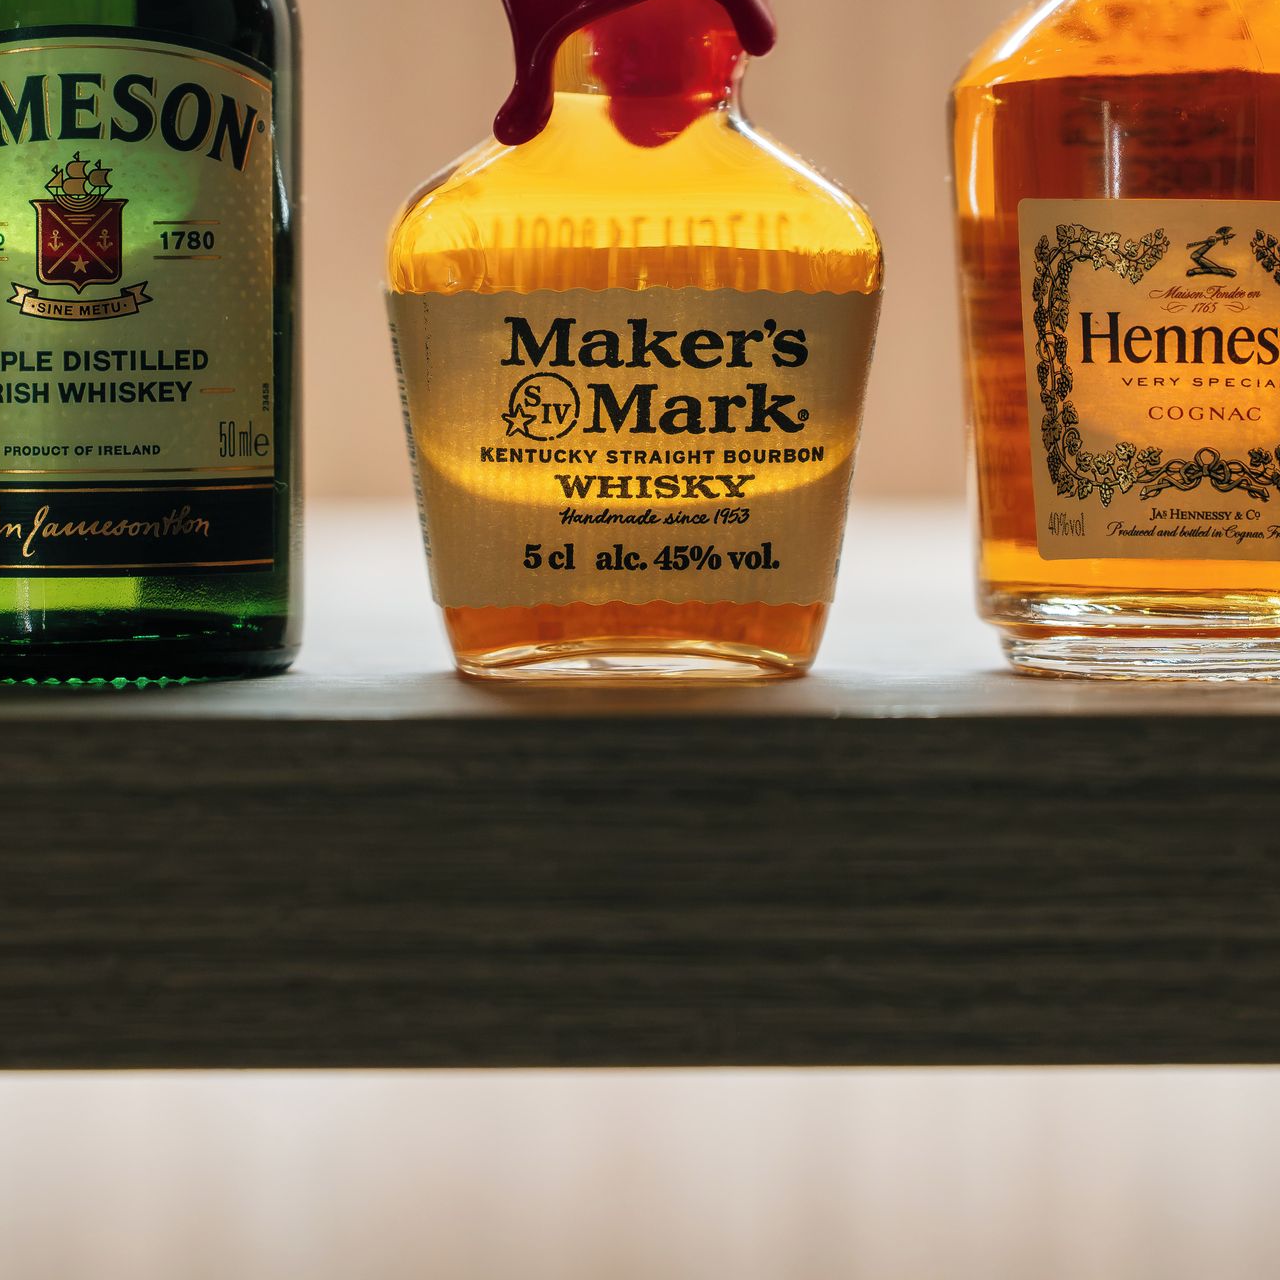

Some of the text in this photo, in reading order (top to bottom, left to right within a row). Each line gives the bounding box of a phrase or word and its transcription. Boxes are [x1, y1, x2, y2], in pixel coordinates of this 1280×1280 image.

[160, 231, 215, 251] 1780
[1149, 285, 1203, 299] Maison
[1247, 291, 1261, 299] en
[37, 300, 121, 316] SINE METU
[1191, 302, 1218, 314] 1765
[500, 317, 809, 368] Maker's
[63, 349, 208, 371] DISTILLED
[1122, 377, 1180, 387] VERY
[59, 381, 193, 403] WHISKEY
[583, 382, 804, 434] Mark
[1149, 406, 1261, 422] COGNAC
[4, 445, 161, 457] PRODUCT OF IRELAND
[480, 446, 824, 465] KENTUCKY STRAIGHT BOURBON
[554, 474, 756, 499] WHISKY
[559, 507, 750, 525] Handmade since 1953
[1170, 509, 1231, 521] HENNESSY
[1234, 510, 1243, 521] &
[1106, 521, 1154, 538] Produced
[1158, 526, 1177, 537] and
[1178, 526, 1210, 537] bottled
[1212, 528, 1222, 537] in
[523, 542, 780, 571] 5 cl alc. 45% vol.
